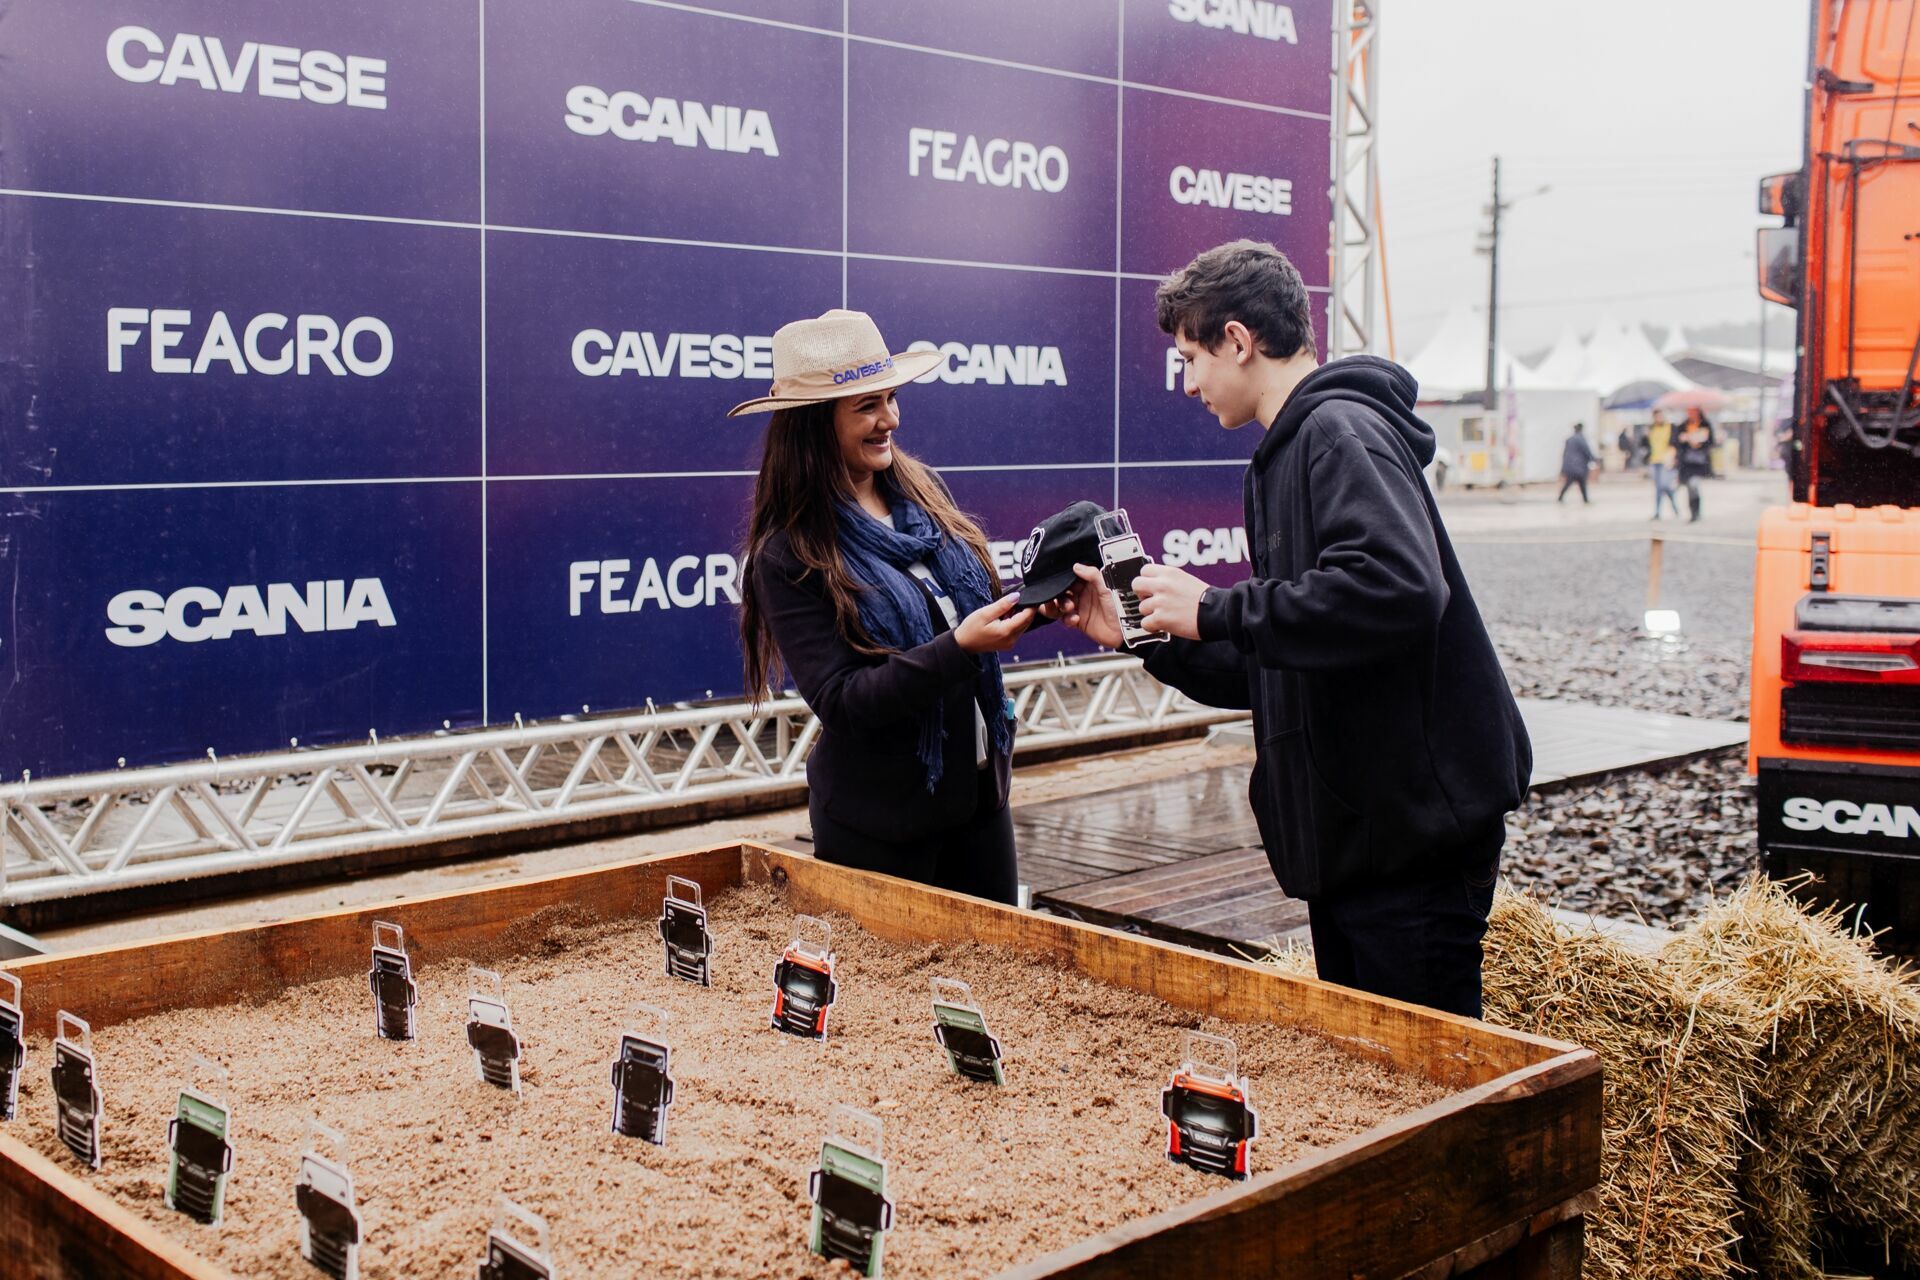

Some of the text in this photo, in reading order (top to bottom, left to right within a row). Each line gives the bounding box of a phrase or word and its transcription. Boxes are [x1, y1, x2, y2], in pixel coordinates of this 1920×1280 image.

[1168, 0, 1298, 45] SCANIA
[106, 25, 388, 110] CAVESE
[564, 85, 780, 158] SCANIA
[909, 127, 1069, 194] FEAGRO
[1169, 165, 1293, 216] CAVESE
[107, 307, 394, 377] FEAGRO
[571, 328, 773, 380] CAVESE
[105, 577, 398, 647] SCANIA
[569, 552, 750, 617] FEAGR
